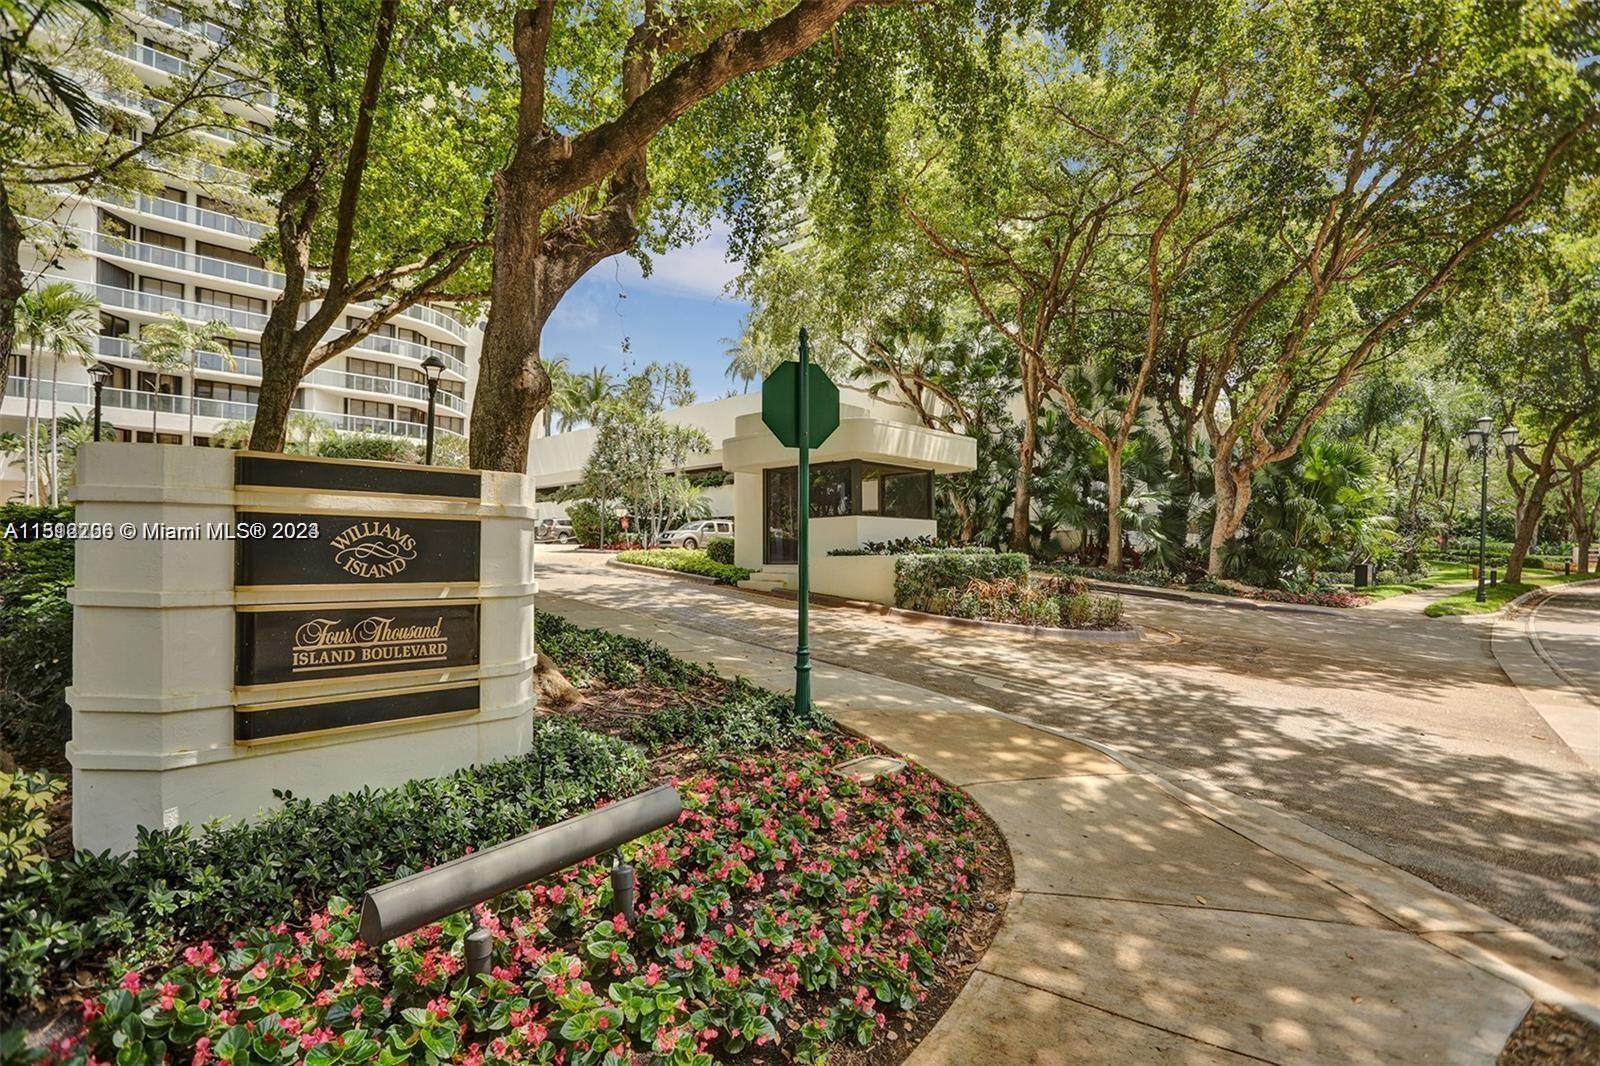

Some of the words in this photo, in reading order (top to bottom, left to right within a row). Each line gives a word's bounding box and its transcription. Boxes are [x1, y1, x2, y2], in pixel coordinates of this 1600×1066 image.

[330, 522, 417, 552] WILLIAMS
[342, 557, 407, 579] ISLAND
[295, 618, 352, 650] Four
[353, 616, 443, 647] Thousand
[292, 650, 356, 666] ISLAND
[361, 642, 449, 662] BOULEVARD
